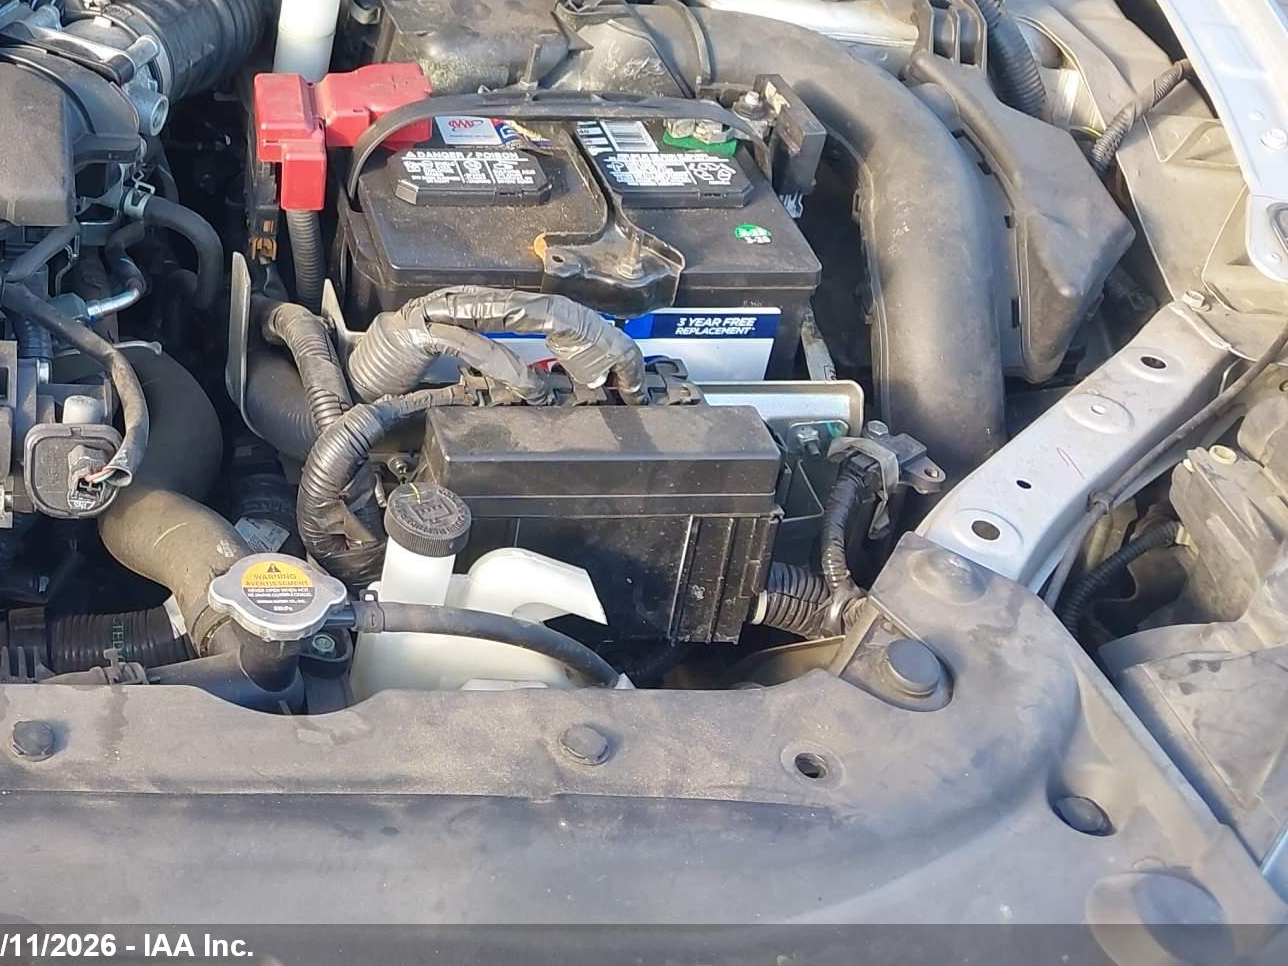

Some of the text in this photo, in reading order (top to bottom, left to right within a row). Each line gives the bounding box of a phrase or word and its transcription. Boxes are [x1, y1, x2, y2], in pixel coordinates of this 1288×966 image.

[677, 317, 757, 327] 3 YEAR FREE
